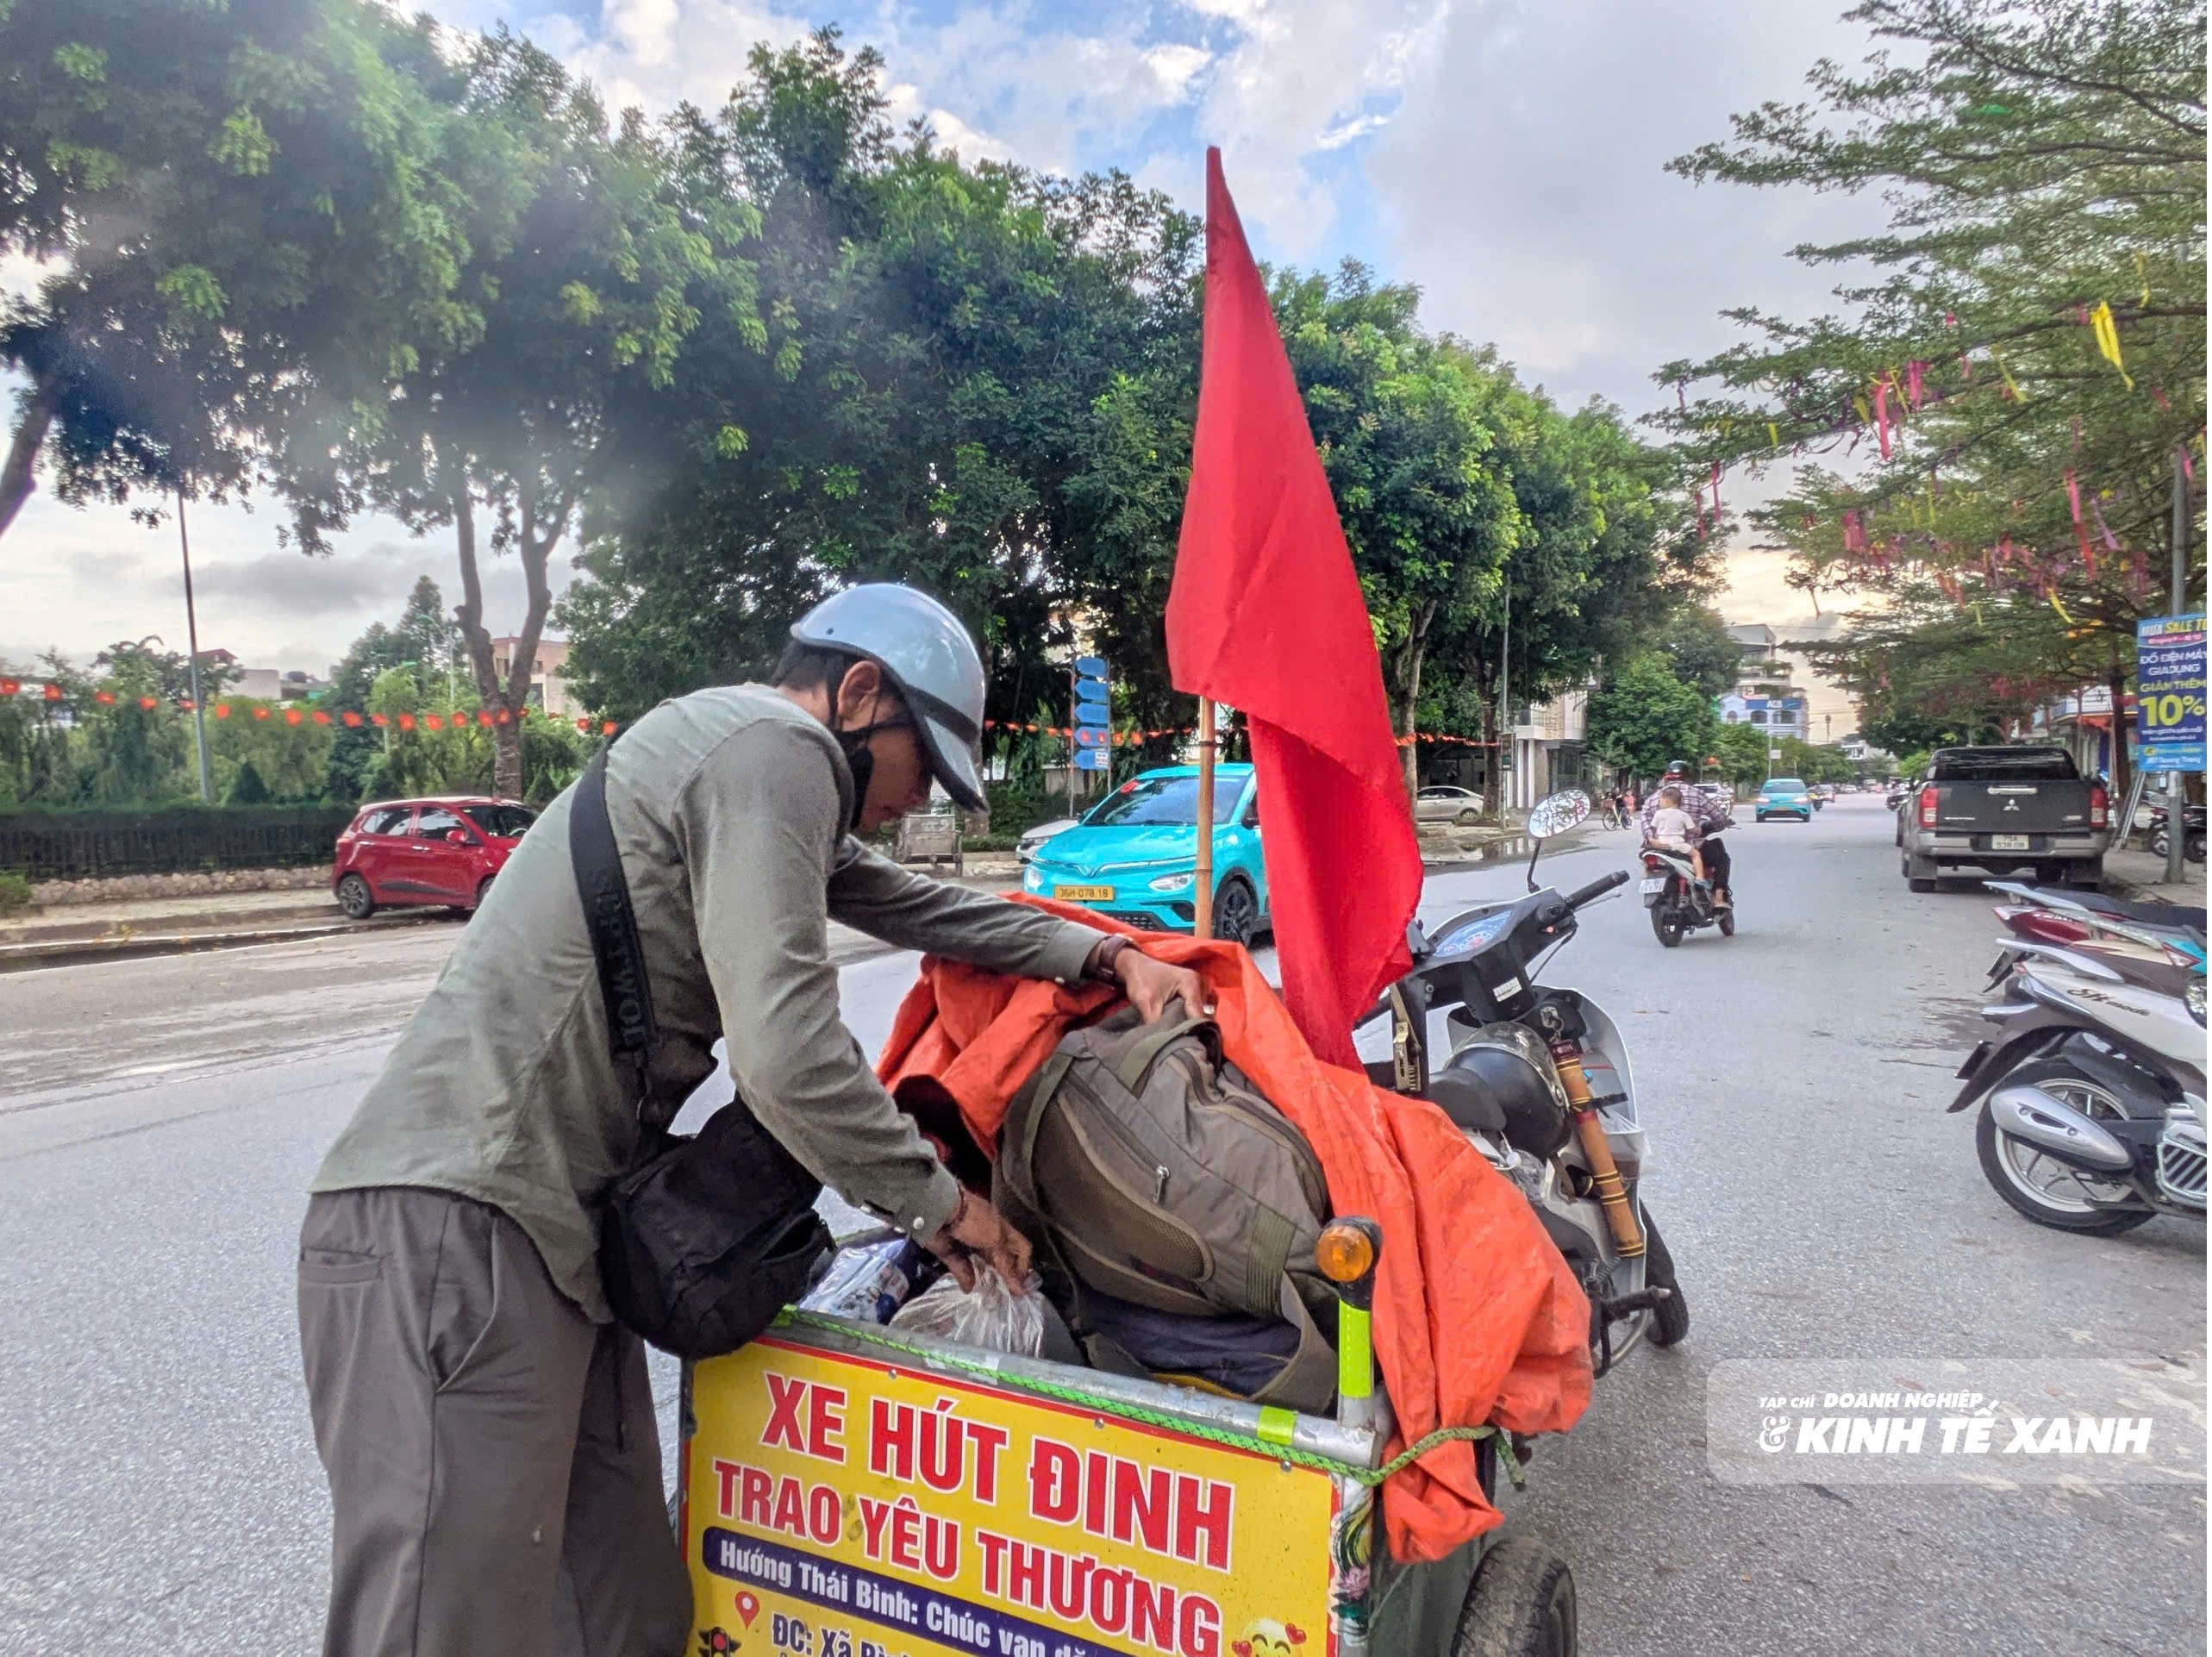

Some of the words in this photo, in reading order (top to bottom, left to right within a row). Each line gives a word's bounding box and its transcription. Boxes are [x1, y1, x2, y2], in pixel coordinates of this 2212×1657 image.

[1766, 699, 1783, 708] ACB
[2140, 694, 2206, 726] 10%
[763, 1371, 847, 1466] XE
[869, 1398, 1010, 1506] HÚT
[1030, 1436, 1236, 1572] ĐINH
[714, 1457, 843, 1548] TRAO
[859, 1496, 960, 1581] YÊU
[976, 1529, 1222, 1657] THƯƠNG
[720, 1540, 791, 1589] Hướng
[798, 1561, 848, 1603] Thái
[856, 1579, 918, 1625] Bình:
[926, 1601, 990, 1648] Chúc
[772, 1613, 814, 1656] ĐC:
